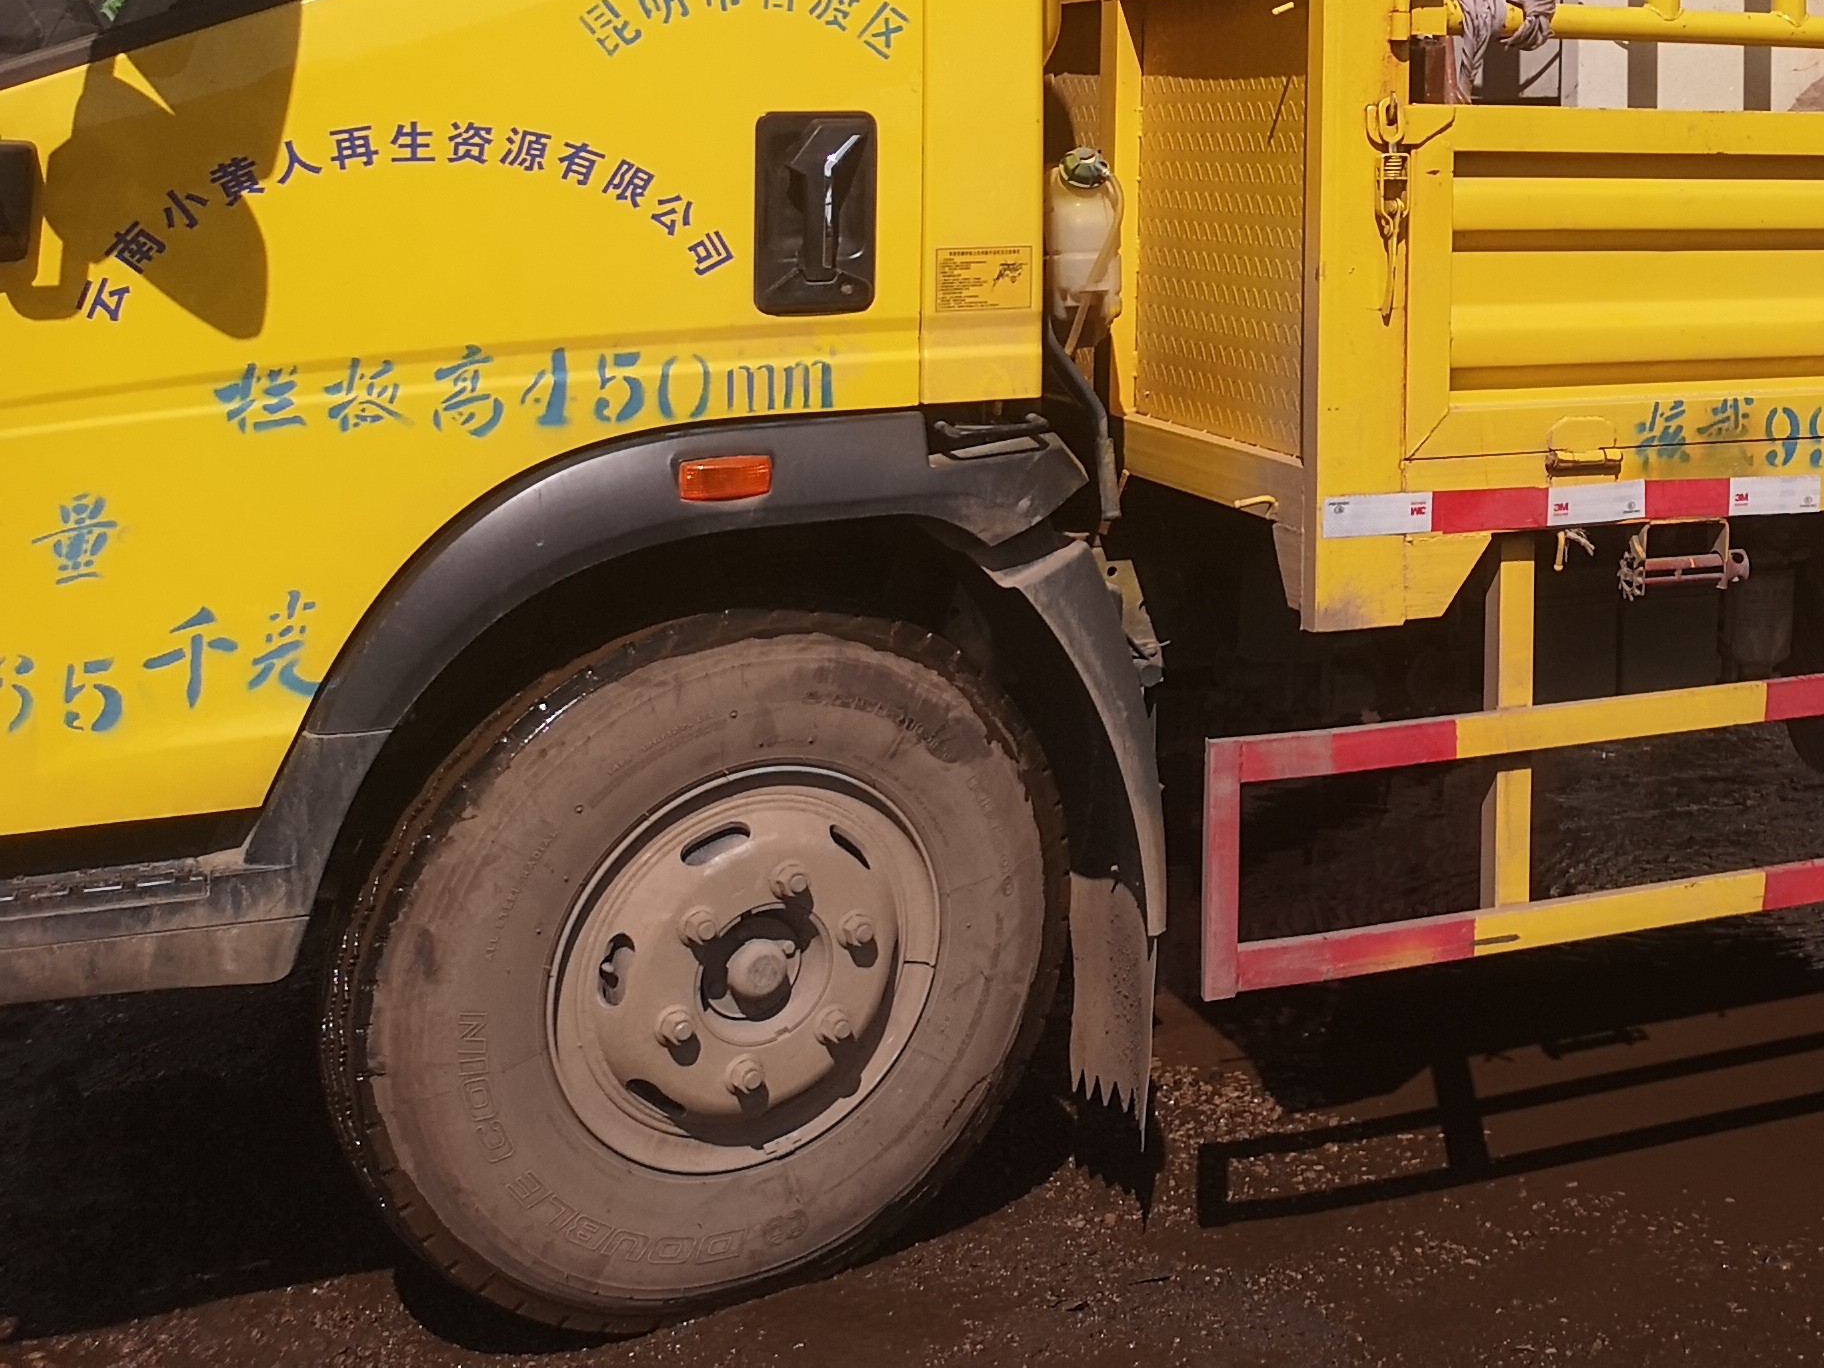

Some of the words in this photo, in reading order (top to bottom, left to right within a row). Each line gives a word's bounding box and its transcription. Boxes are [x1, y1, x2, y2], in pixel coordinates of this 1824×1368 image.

[75, 120, 736, 324] 云南小黄人再生资源有限公司
[31, 491, 118, 586] 量
[456, 1011, 516, 1164] COIN
[504, 1169, 750, 1265] DOUBLE
